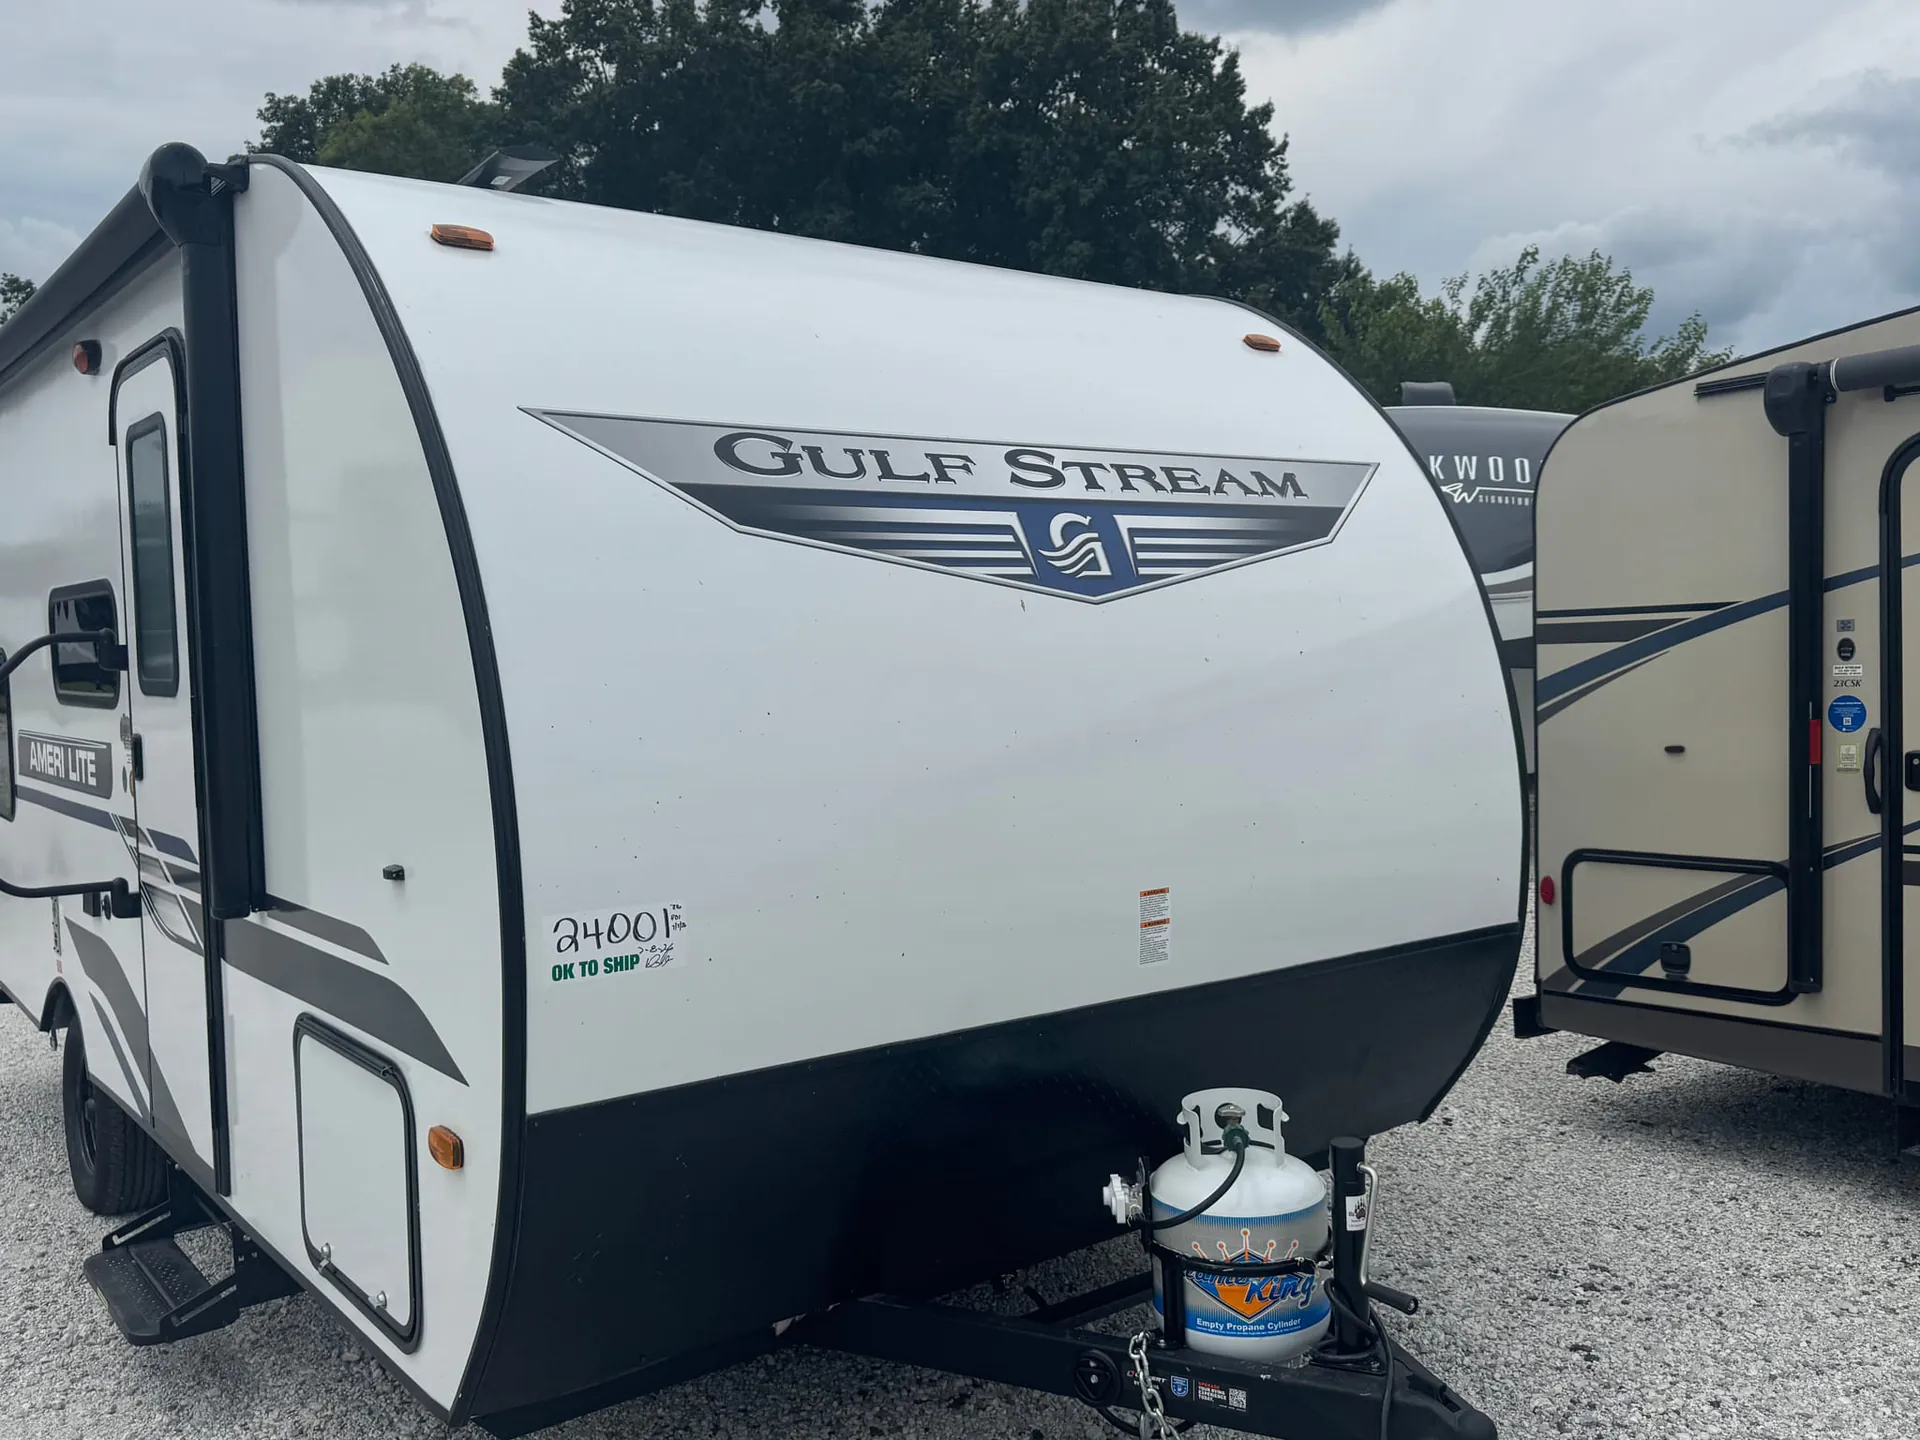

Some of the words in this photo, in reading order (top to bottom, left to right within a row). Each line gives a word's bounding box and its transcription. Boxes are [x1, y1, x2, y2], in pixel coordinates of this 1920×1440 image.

[713, 432, 975, 486] GULF
[1004, 448, 1309, 499] STREAM
[1429, 455, 1543, 483] KWOO
[1833, 679, 1862, 688] 23CSK
[29, 741, 65, 779] AMERI
[68, 747, 97, 787] LITE
[553, 907, 670, 953] 24001
[551, 962, 575, 982] OK
[579, 959, 599, 978] TO
[603, 953, 640, 974] SHIP
[1243, 1273, 1316, 1308] King
[1196, 1318, 1224, 1331] Empty
[1226, 1322, 1265, 1332] Propane
[1267, 1318, 1301, 1331] Cylinder
